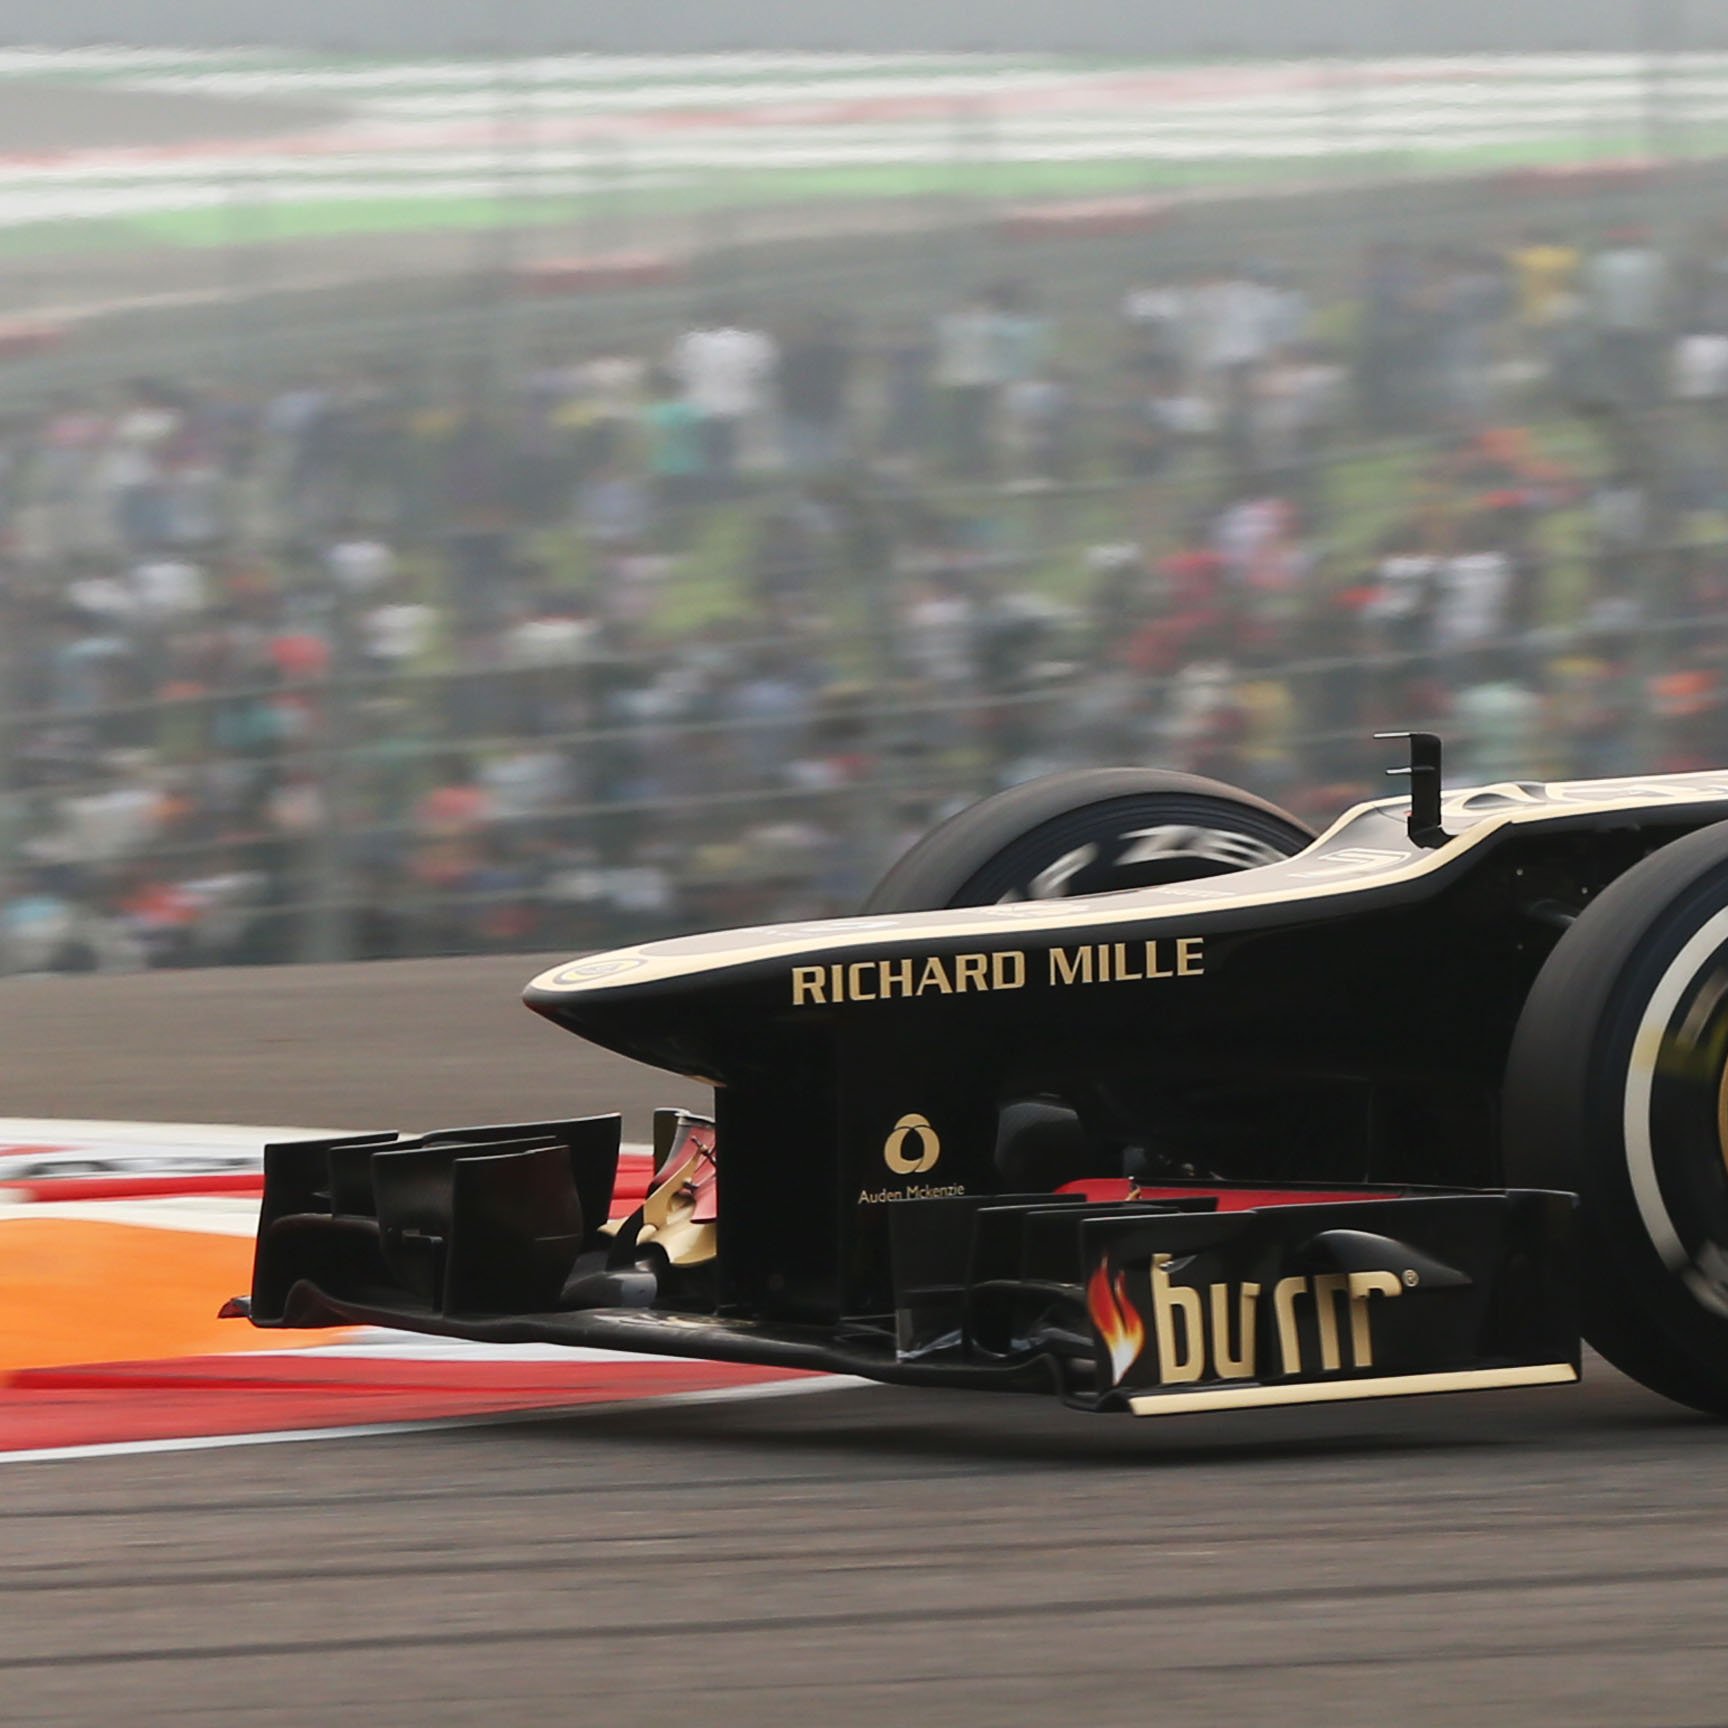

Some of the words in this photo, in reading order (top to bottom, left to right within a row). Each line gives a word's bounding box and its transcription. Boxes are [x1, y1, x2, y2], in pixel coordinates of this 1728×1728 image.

[791, 950, 1026, 1006] RICHARD
[1048, 937, 1206, 987] MILLE
[857, 1187, 903, 1205] Auden
